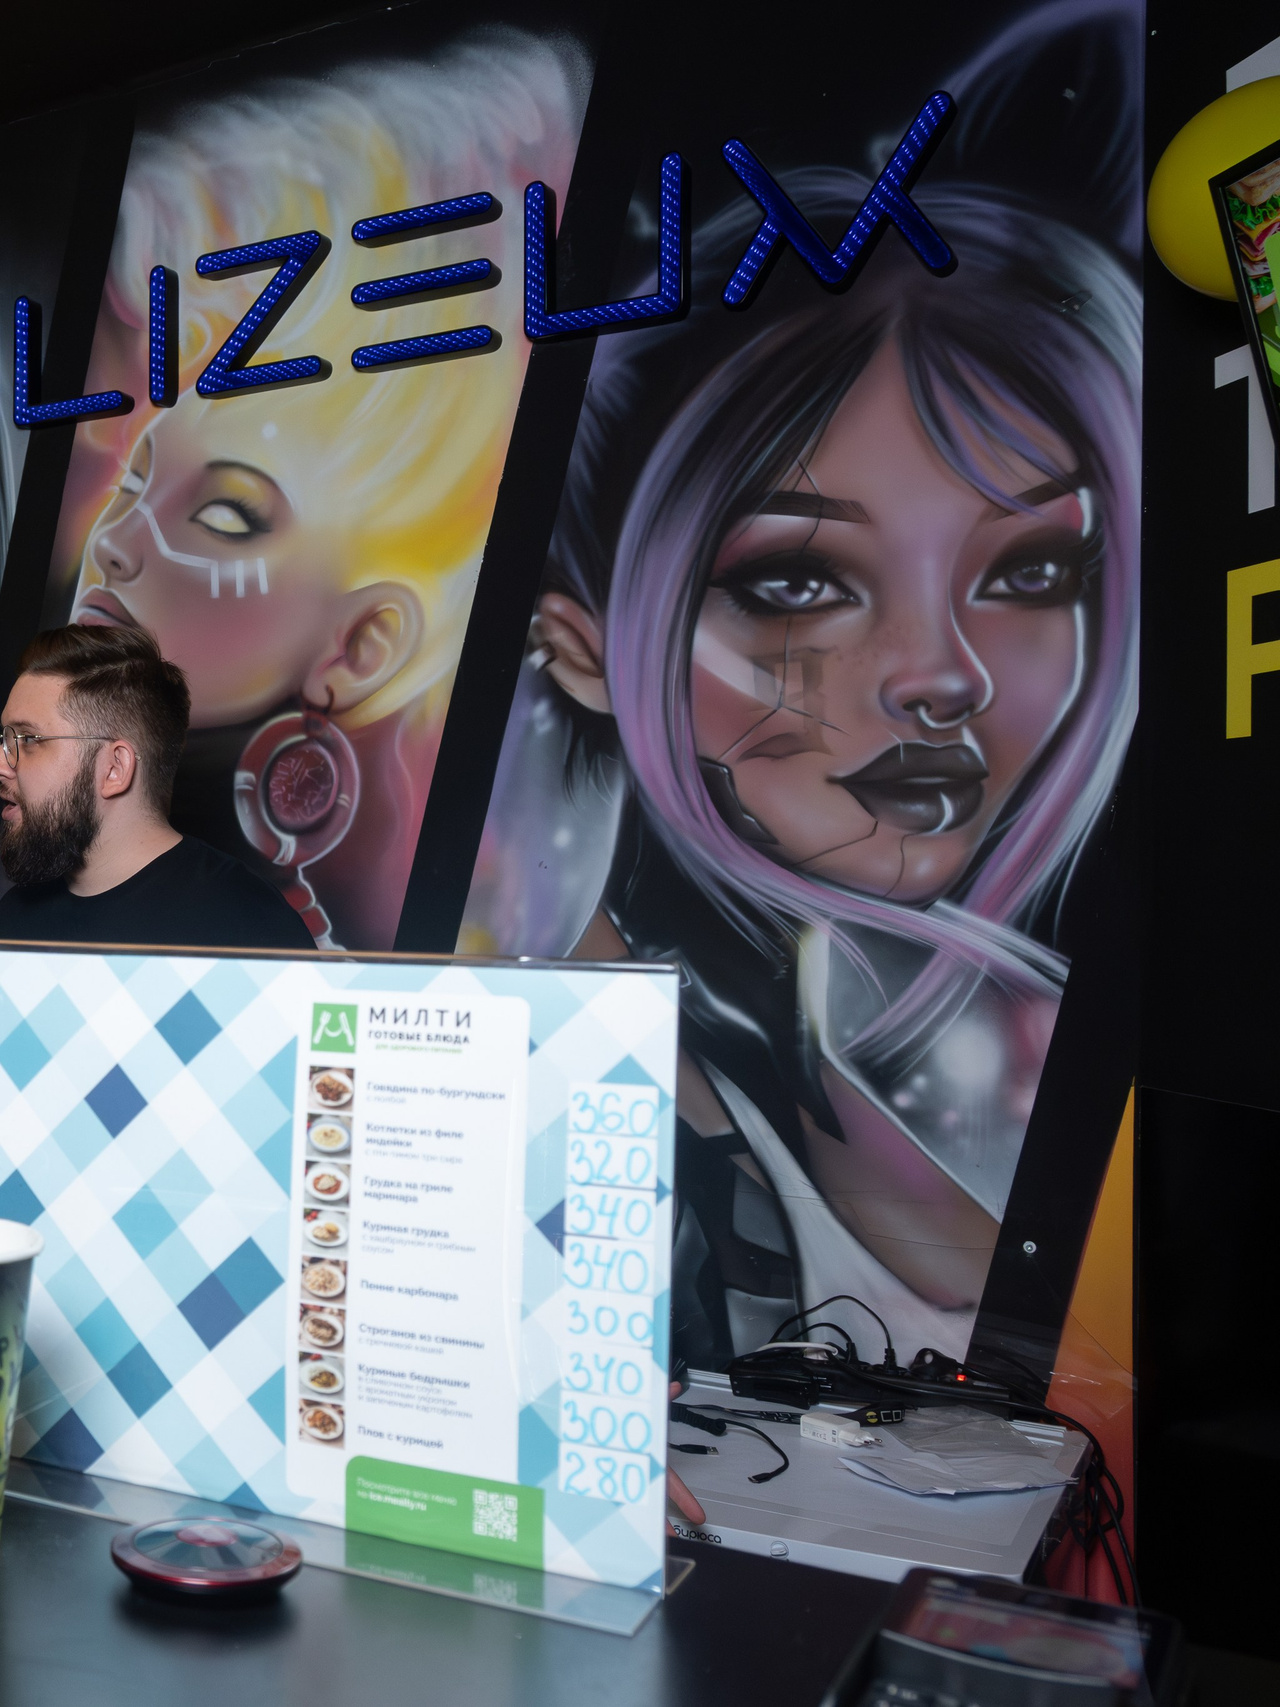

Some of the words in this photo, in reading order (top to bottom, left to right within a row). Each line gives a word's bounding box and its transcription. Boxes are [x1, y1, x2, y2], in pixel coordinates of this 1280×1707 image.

[368, 1006, 472, 1029] МИЛТИ
[368, 1029, 422, 1042] ГОТОВЫЕ
[426, 1032, 471, 1045] БЛЮДА
[571, 1090, 658, 1137] 360
[570, 1139, 653, 1187] 320
[569, 1191, 653, 1238] 340
[563, 1240, 649, 1294] 340
[567, 1299, 655, 1343] 300
[565, 1352, 645, 1396] 340
[562, 1399, 653, 1453] 300
[563, 1452, 647, 1503] 280
